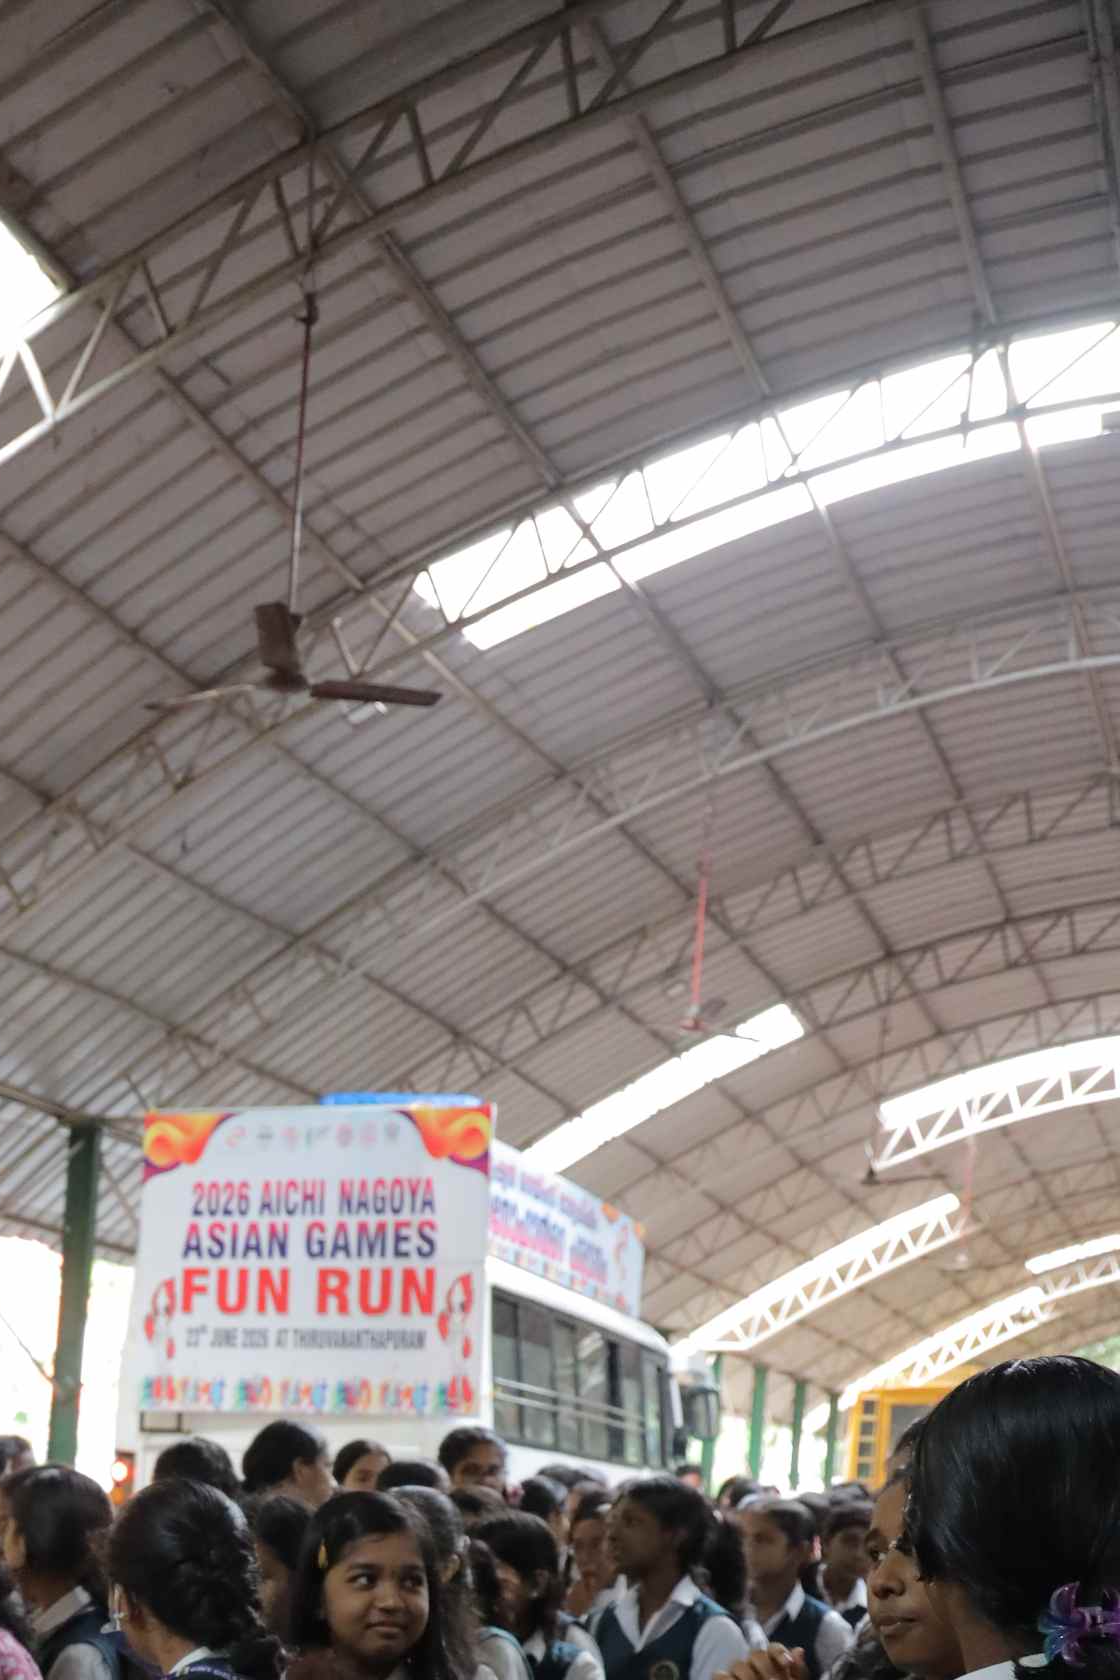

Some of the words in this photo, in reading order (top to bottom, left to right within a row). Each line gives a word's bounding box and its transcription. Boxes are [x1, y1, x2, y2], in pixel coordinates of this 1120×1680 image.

[192, 1181, 251, 1216] 2026
[259, 1179, 326, 1216] AICHI
[339, 1176, 436, 1215] NAGOYA
[183, 1220, 289, 1258] ASIAN
[305, 1219, 437, 1258] GAMES
[182, 1267, 290, 1315] FUN
[317, 1267, 436, 1316] RUN
[210, 1328, 237, 1348] JUNE
